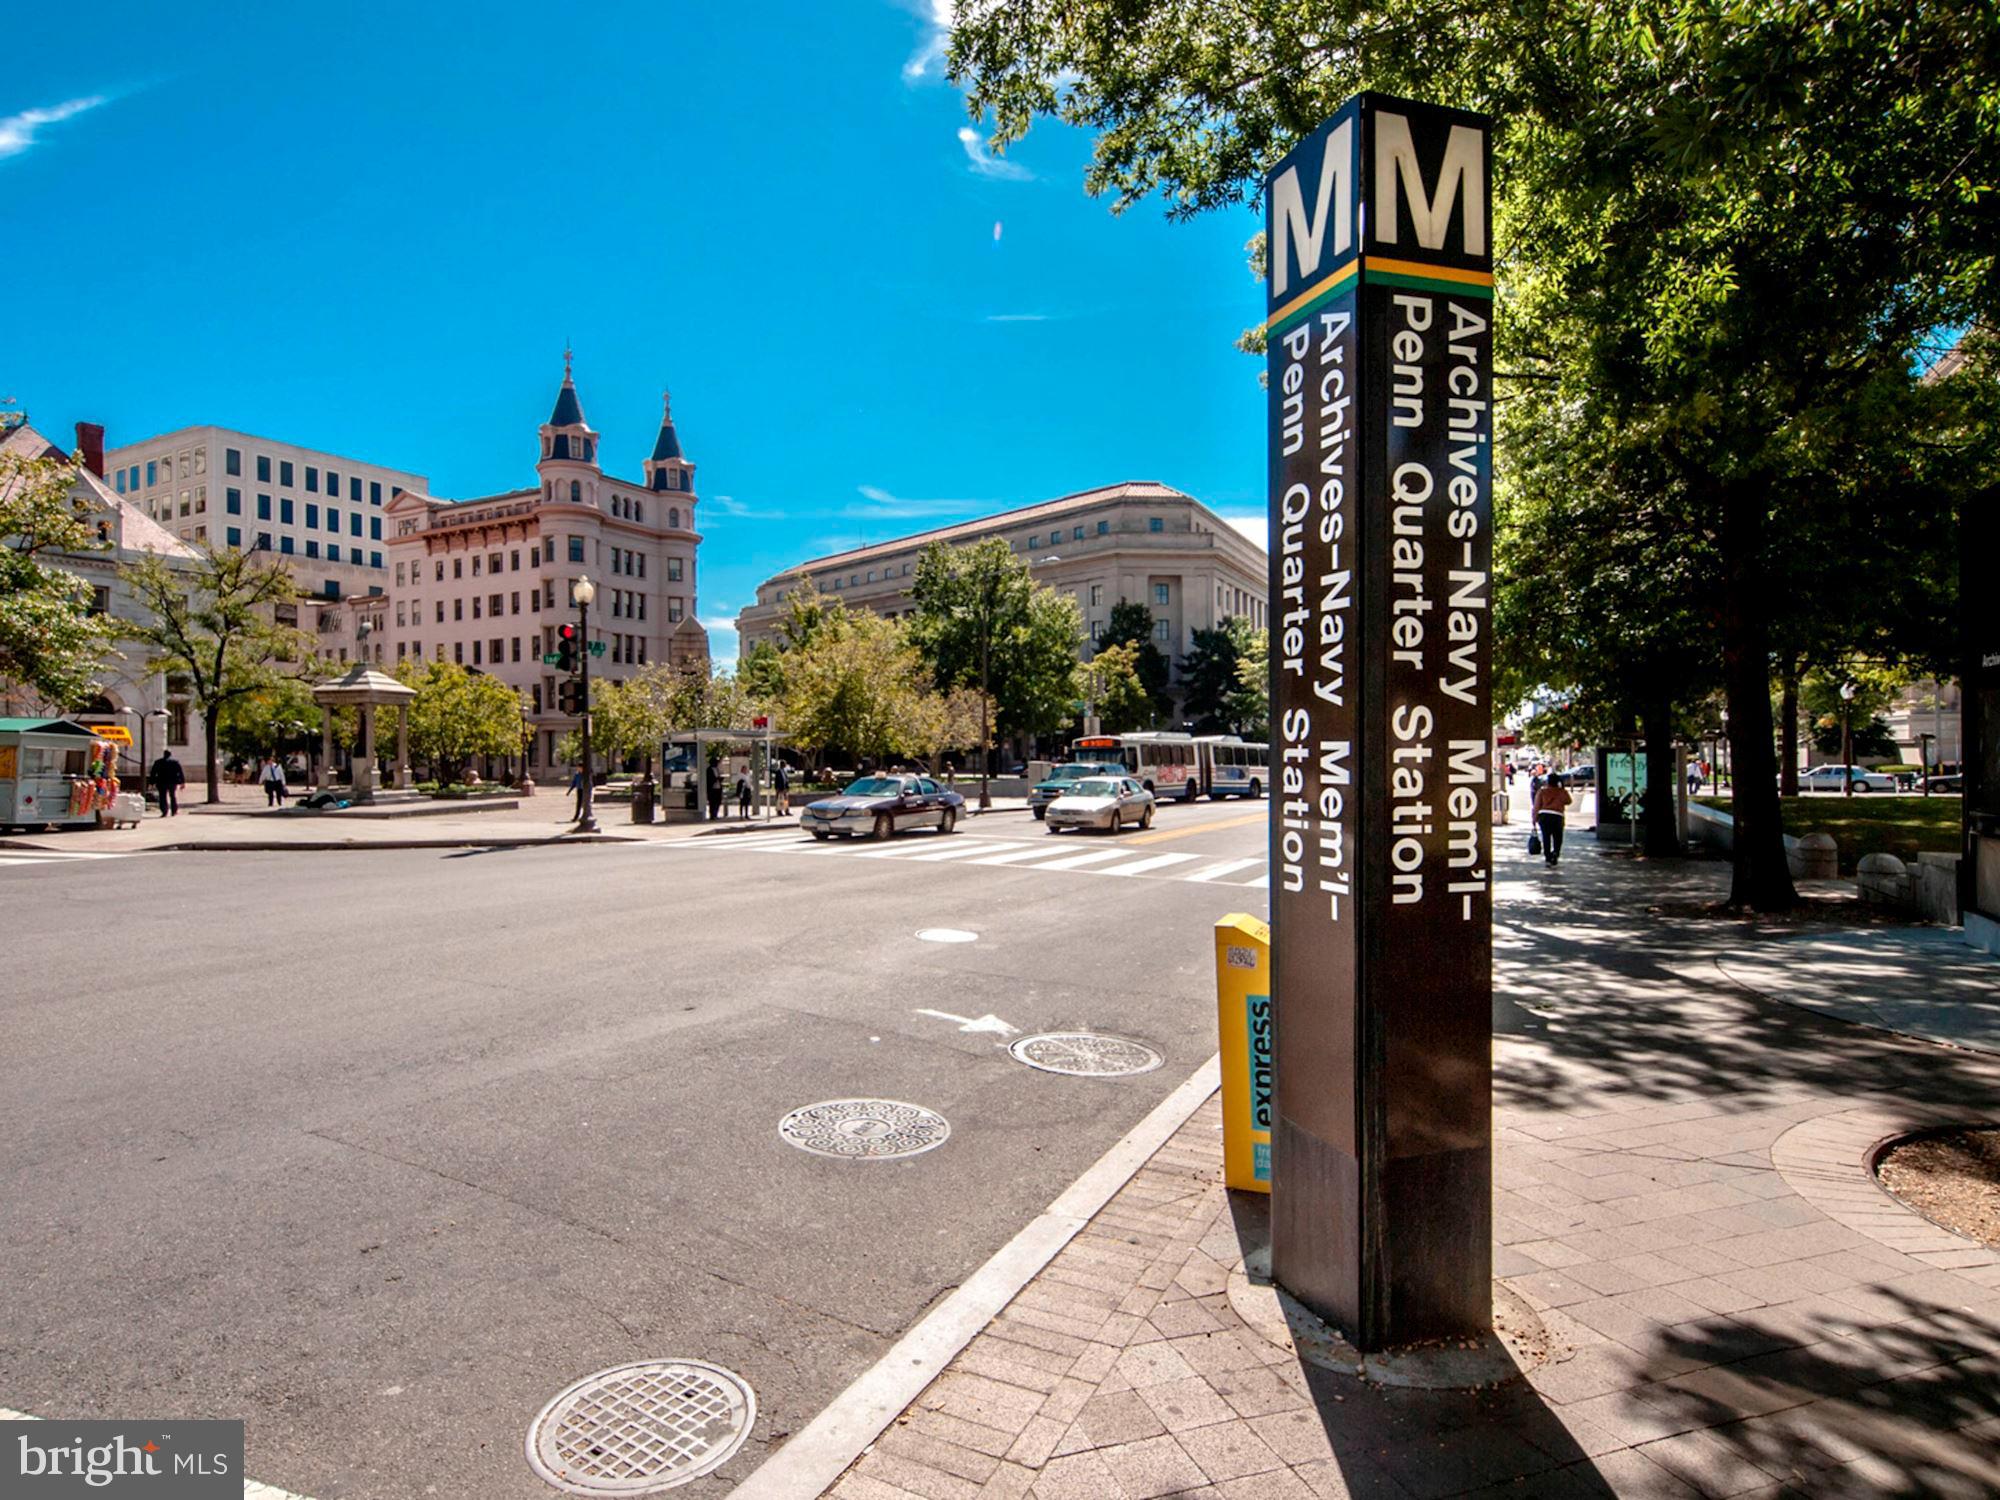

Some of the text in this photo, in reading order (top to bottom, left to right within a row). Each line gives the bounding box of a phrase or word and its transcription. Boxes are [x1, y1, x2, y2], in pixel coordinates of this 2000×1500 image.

[1273, 117, 1352, 298] M
[1374, 110, 1485, 256] M
[1281, 322, 1311, 893] Penn Quarter Station
[1313, 311, 1351, 707] Archives-Navy
[1391, 294, 1434, 905] Penn Quarter Station
[1438, 301, 1487, 706] Archives-Navy
